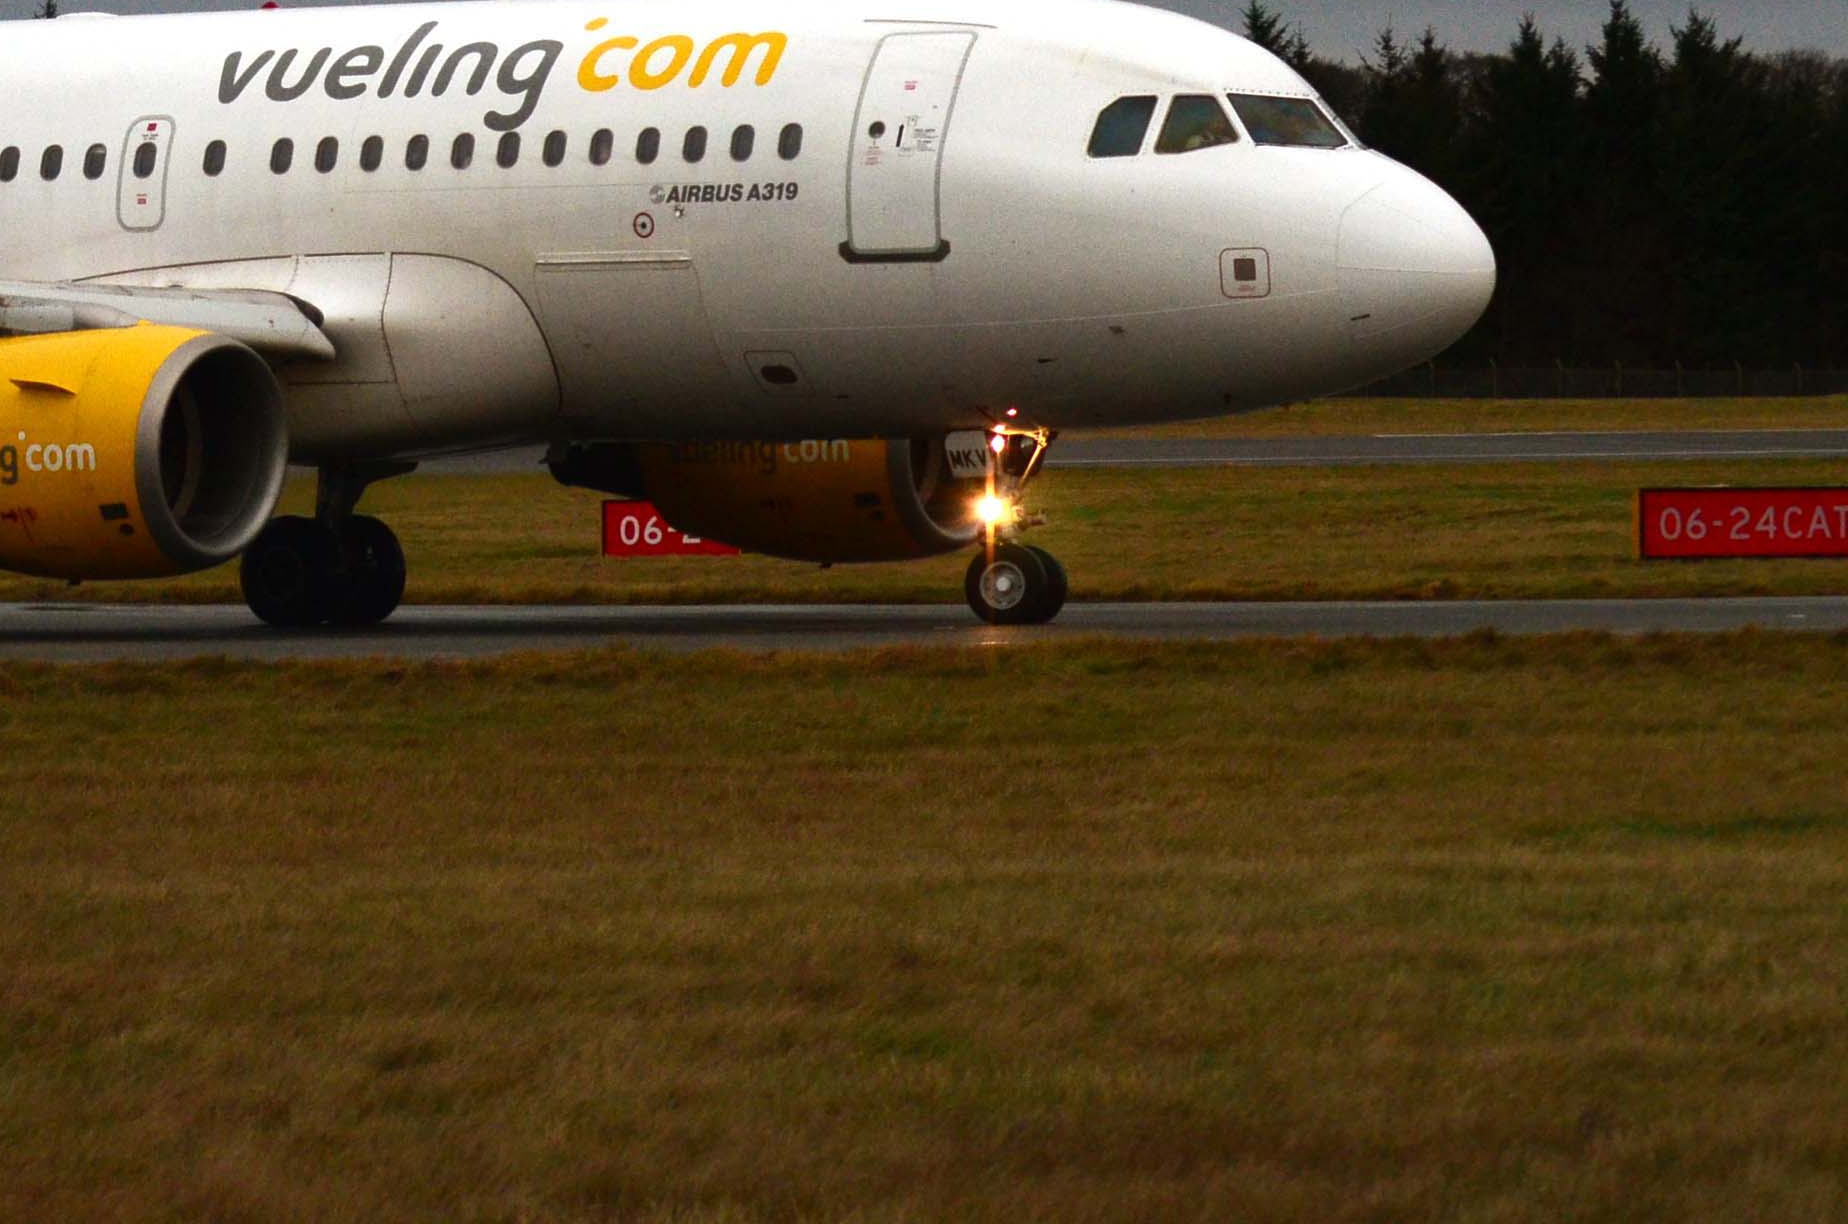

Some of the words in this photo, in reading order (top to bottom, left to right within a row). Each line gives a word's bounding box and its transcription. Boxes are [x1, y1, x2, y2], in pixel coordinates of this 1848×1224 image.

[666, 183, 744, 203] AIRBUS
[746, 182, 799, 201] A319
[949, 449, 987, 469] MKV
